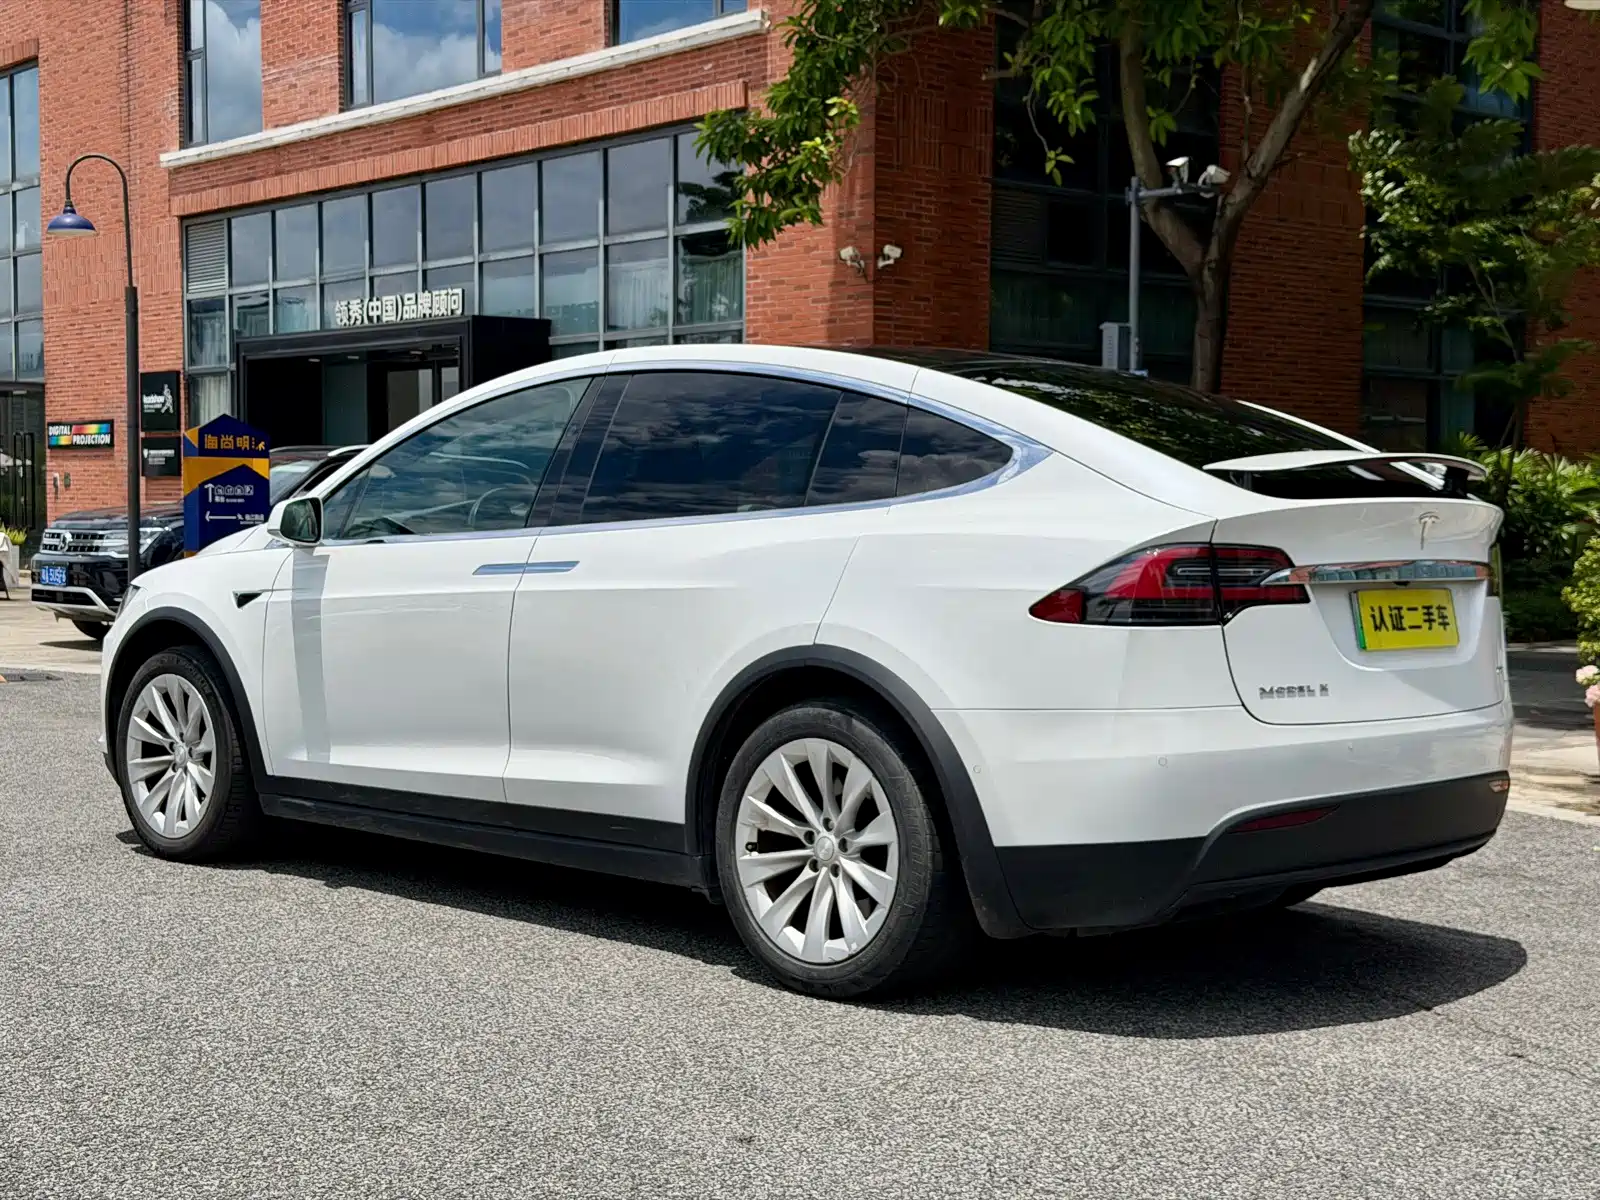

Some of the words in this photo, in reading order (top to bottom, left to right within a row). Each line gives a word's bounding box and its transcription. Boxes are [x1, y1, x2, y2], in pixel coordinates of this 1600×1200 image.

[335, 287, 463, 328] 领秀(中国)品牌顾问
[48, 424, 71, 436] DIGITAL
[72, 433, 111, 445] PROJECTION
[1369, 604, 1450, 632] 认证二手车
